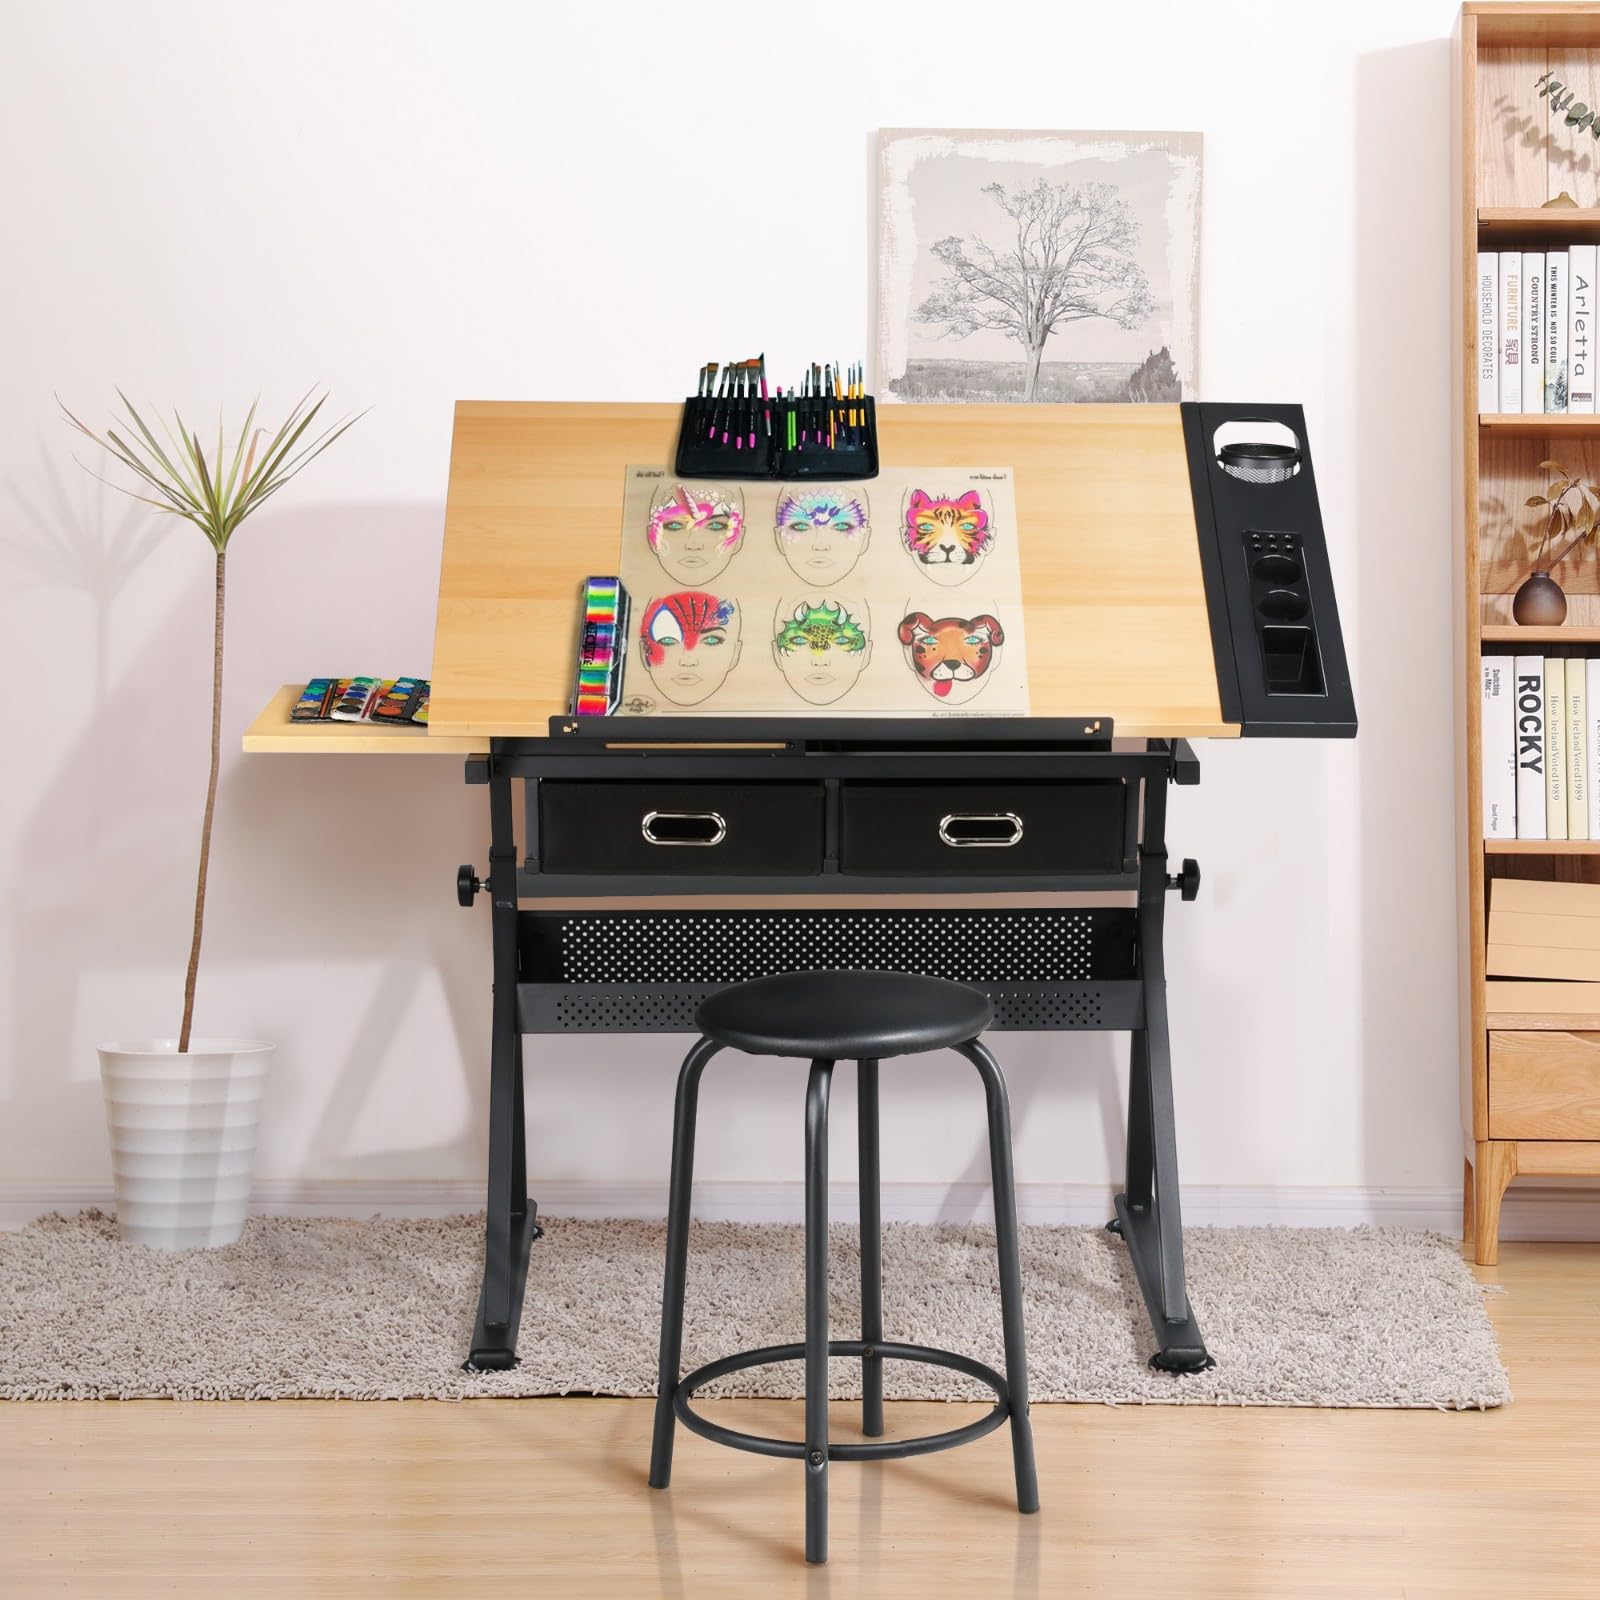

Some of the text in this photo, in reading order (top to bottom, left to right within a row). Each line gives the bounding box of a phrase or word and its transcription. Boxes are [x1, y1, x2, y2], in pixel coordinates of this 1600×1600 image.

[1507, 275, 1518, 331] FURNITURE
[1530, 276, 1540, 365] COUNTRY STRONG
[1550, 310, 1557, 318] IS
[1482, 275, 1493, 380] HOUSEHOLD DECORATES
[1550, 336, 1557, 345] SO
[1574, 275, 1590, 377] Arletta
[1505, 338, 1519, 365] 家具
[1518, 675, 1543, 775] ROCKY
[1550, 695, 1559, 716] How
[1572, 695, 1580, 716] How
